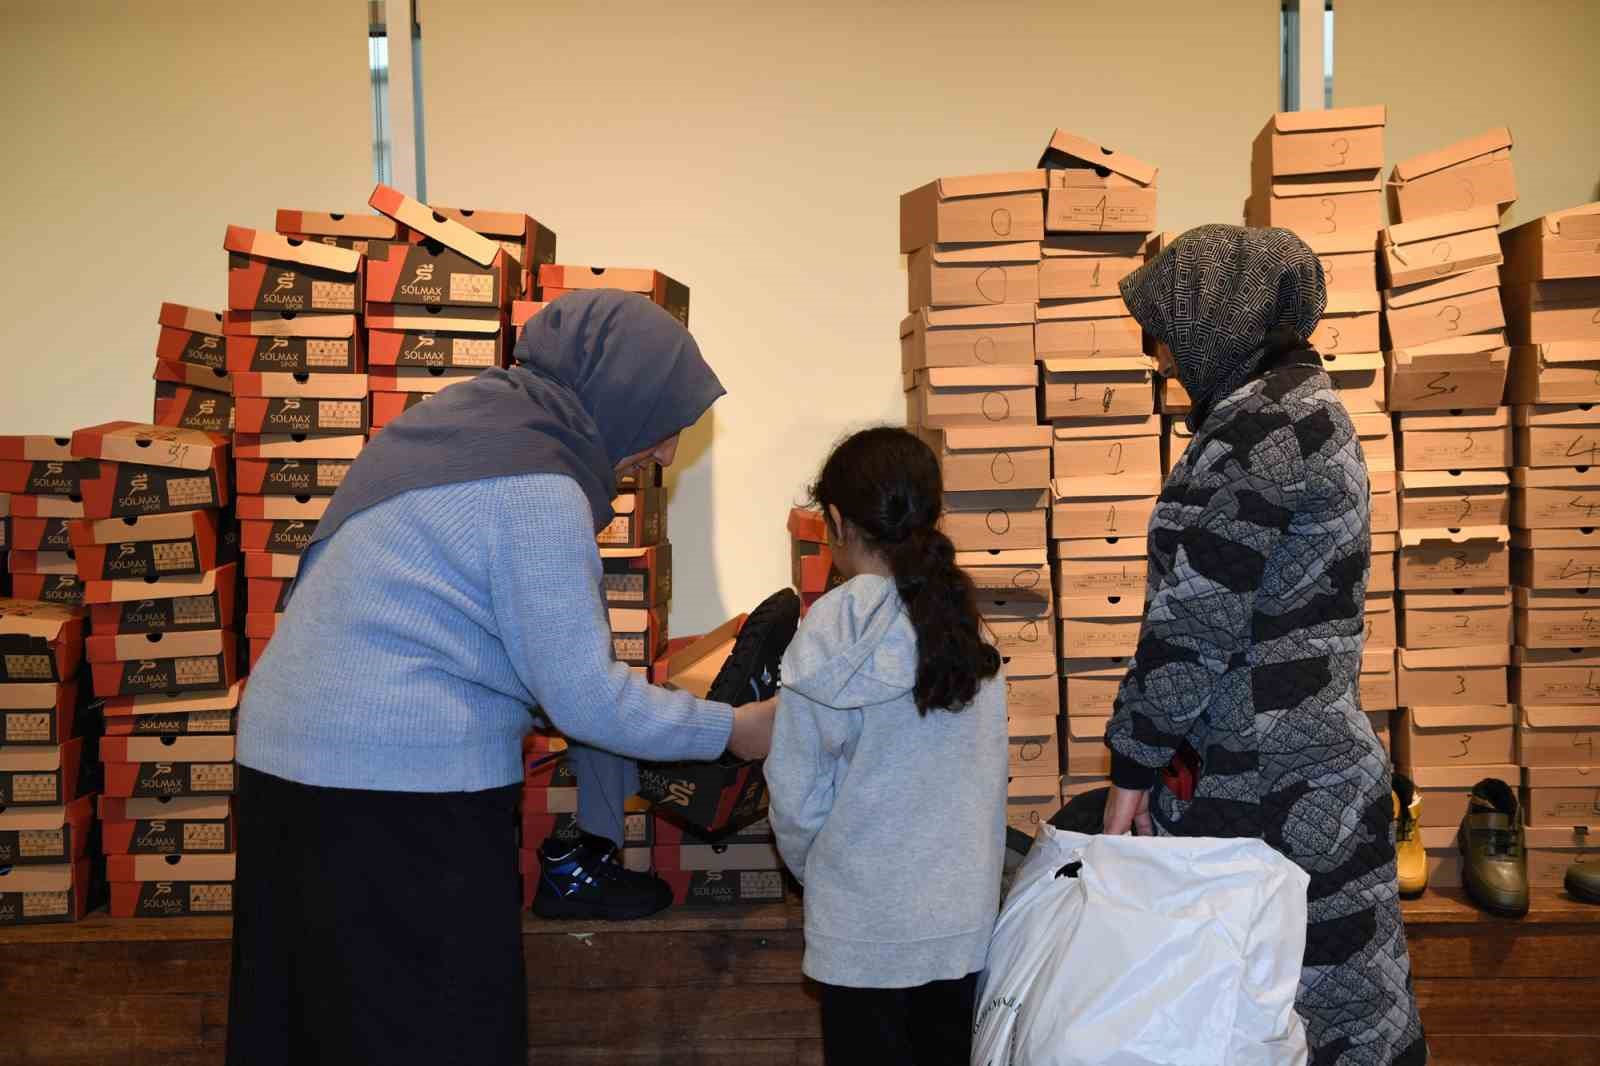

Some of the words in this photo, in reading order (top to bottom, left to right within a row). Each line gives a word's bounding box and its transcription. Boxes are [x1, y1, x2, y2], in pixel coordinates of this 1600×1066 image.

[1325, 137, 1349, 168] 3
[1315, 198, 1337, 235] 3
[400, 285, 442, 296] SOLMAX
[263, 294, 304, 304] SOLMAX
[1435, 305, 1462, 331] 3
[1325, 326, 1340, 350] 3
[187, 350, 224, 362] SOLMAX
[259, 352, 299, 361] SOLMAX
[404, 350, 444, 360] SOLMAX
[185, 416, 223, 425] SOLMAX
[270, 414, 311, 424] SOLMAX
[270, 473, 310, 482] SOLMAX
[32, 479, 72, 488] SOLMAX
[119, 495, 161, 506] SOLMAX
[1104, 505, 1118, 532] 1
[109, 560, 147, 570] SOLMAX
[127, 613, 167, 623] SOLMAX
[127, 673, 168, 684] SOLMAX
[1453, 675, 1466, 695] 3
[140, 720, 180, 729] SOLMAX
[1448, 735, 1472, 759] 3
[141, 779, 182, 789] SOLMAX
[137, 837, 176, 847] SOLMAX
[143, 899, 182, 909] SOLMAX
